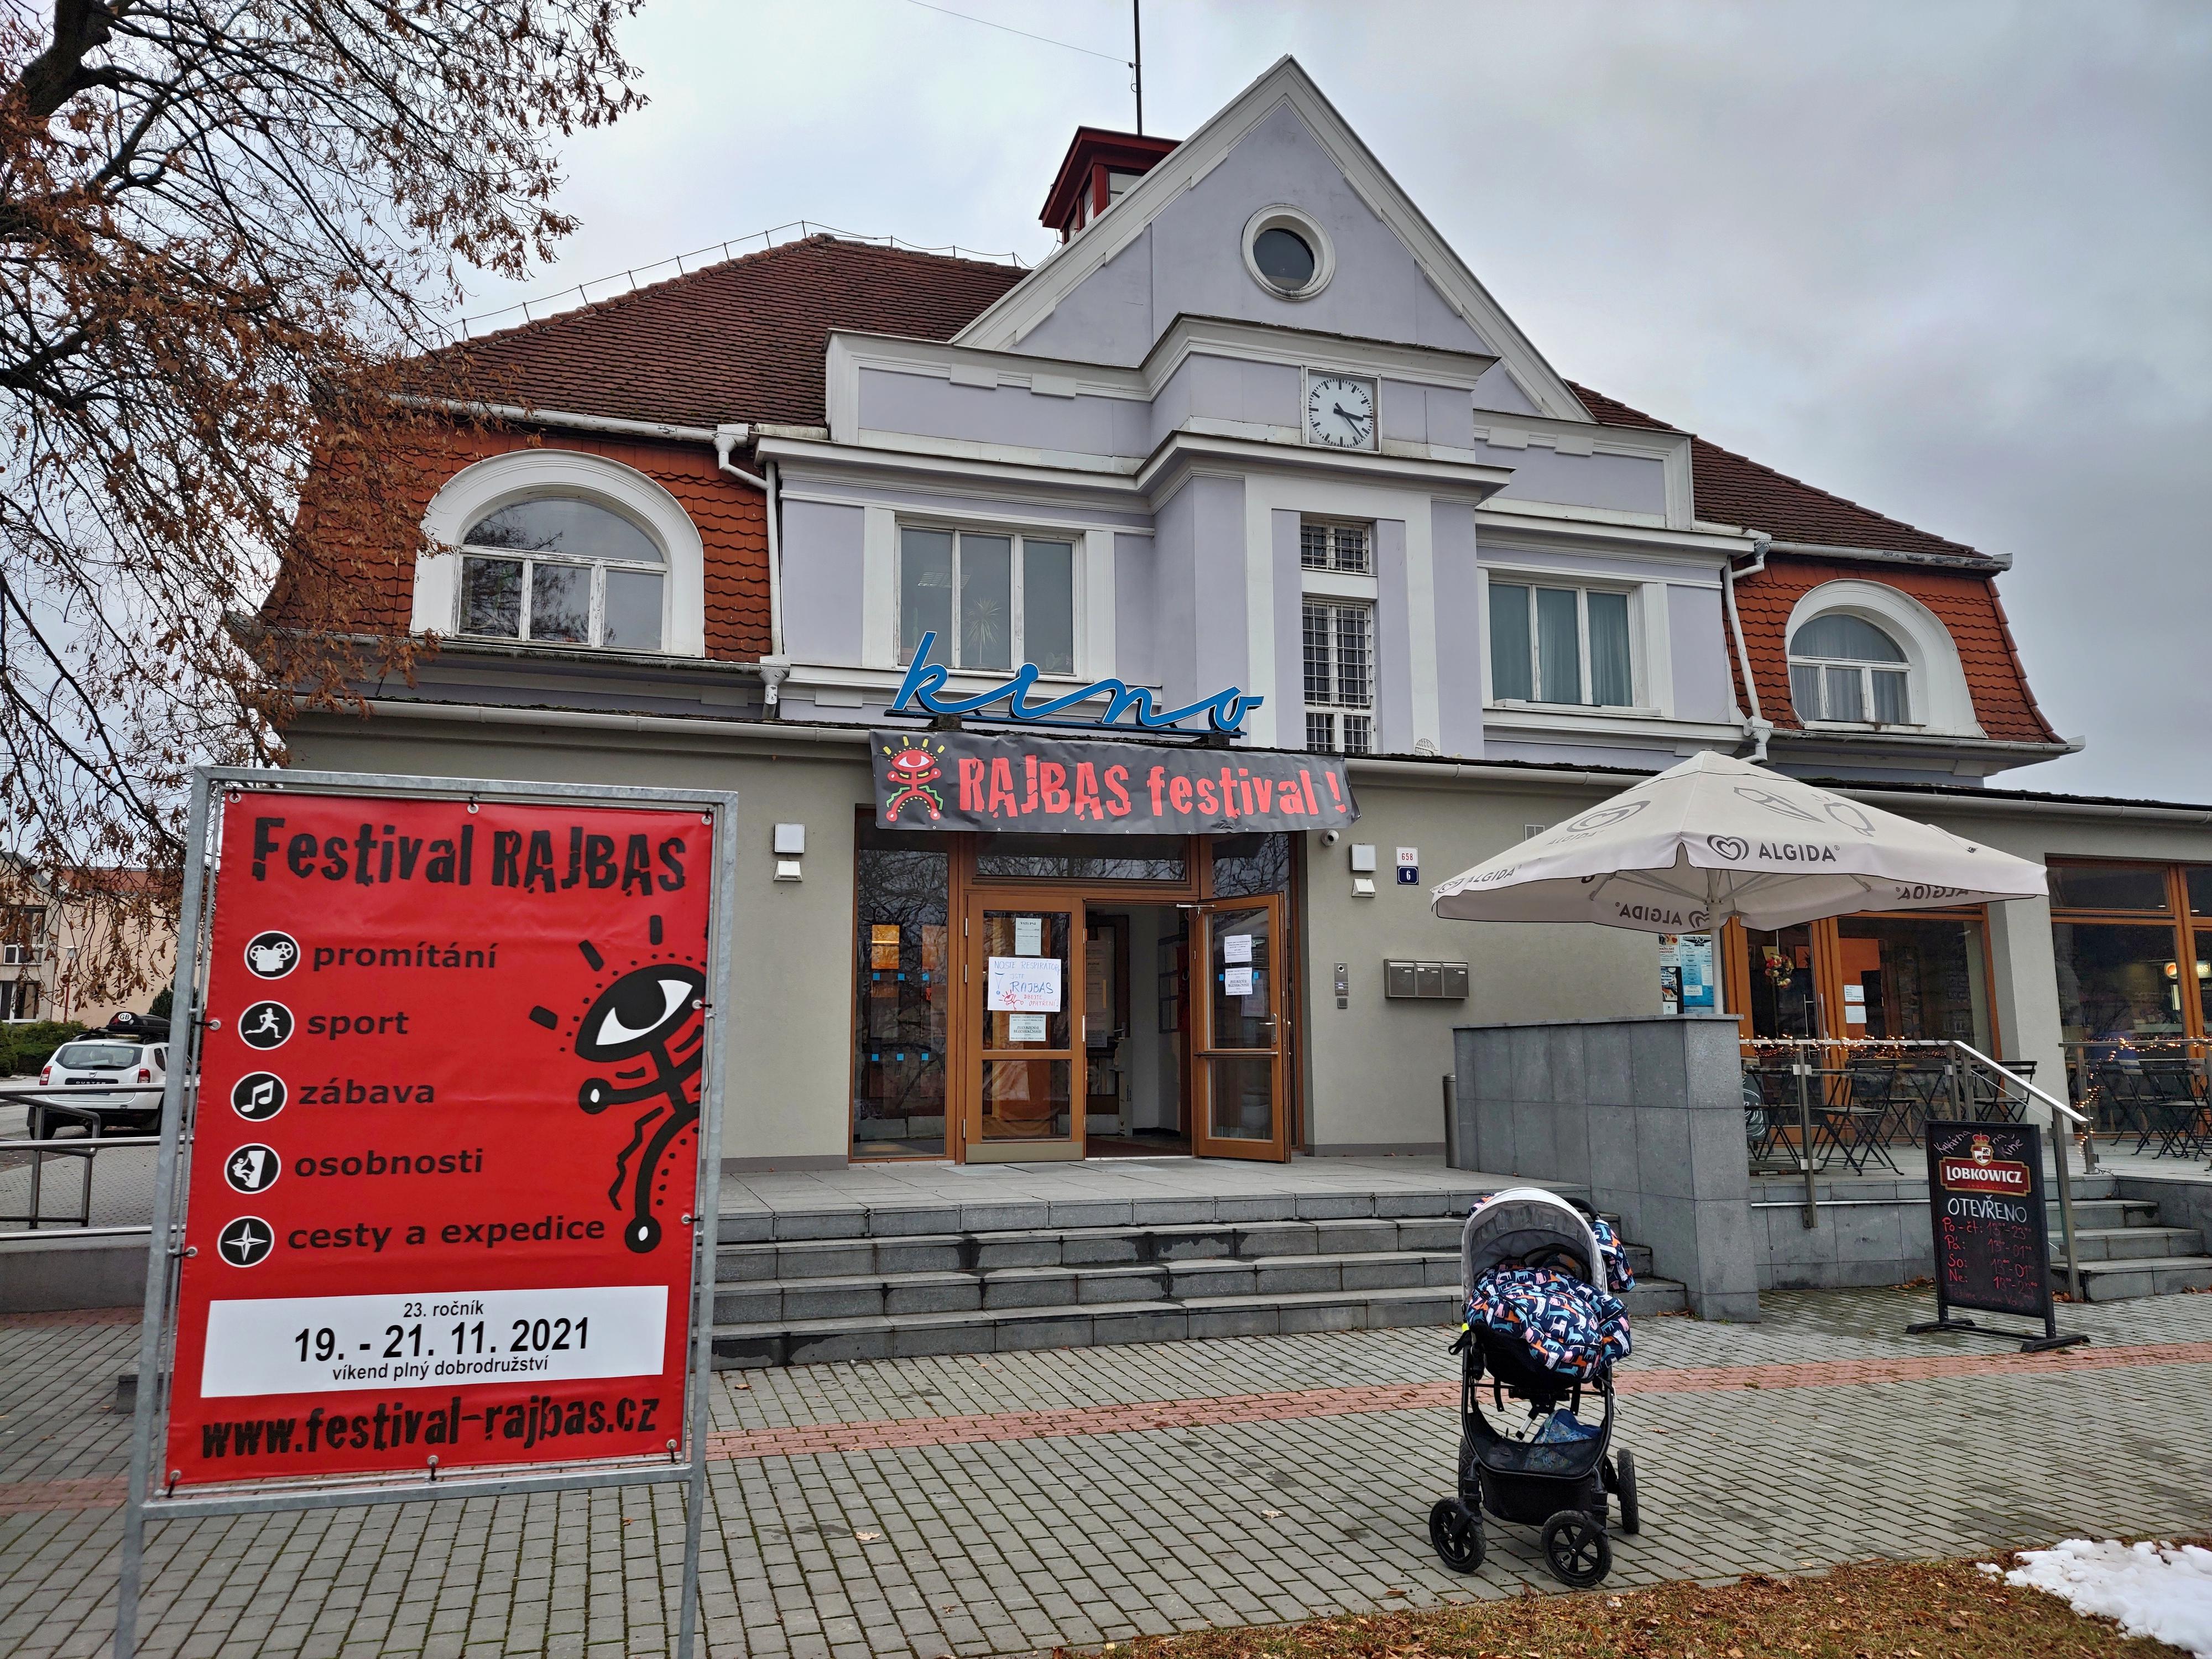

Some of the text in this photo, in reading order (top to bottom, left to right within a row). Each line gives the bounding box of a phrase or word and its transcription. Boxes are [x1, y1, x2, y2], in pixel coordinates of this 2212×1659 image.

[893, 631, 1264, 730] kino
[959, 755, 1131, 821] RAJBAS
[1146, 765, 1319, 818] festival
[252, 817, 686, 897] Festival RAJBAS
[1759, 842, 1837, 863] ALGIDA
[1406, 870, 1411, 880] 6
[1467, 866, 1516, 885] ALGIDA
[313, 941, 498, 972] promítání
[994, 960, 1016, 969] NOSTE
[1010, 981, 1053, 994] RAJBAS
[307, 1011, 409, 1040] sport
[299, 1077, 435, 1105] zábava
[294, 1148, 483, 1177] osobnosti
[1946, 1165, 2023, 1183] LOBKOWICZ
[1948, 1194, 2027, 1223] OTEVŘENO
[288, 1215, 605, 1253] cesty a expedice
[1942, 1217, 1955, 1232] Po
[1947, 1253, 1968, 1268] So:
[1949, 1269, 1968, 1282] Ne:
[403, 1300, 484, 1318] 23. ročník
[295, 1317, 588, 1362] 19. - 21. 11. 2021
[332, 1355, 549, 1382] víkend plný dobrodružství
[201, 1394, 660, 1459] www.festival-rajbas.cz
